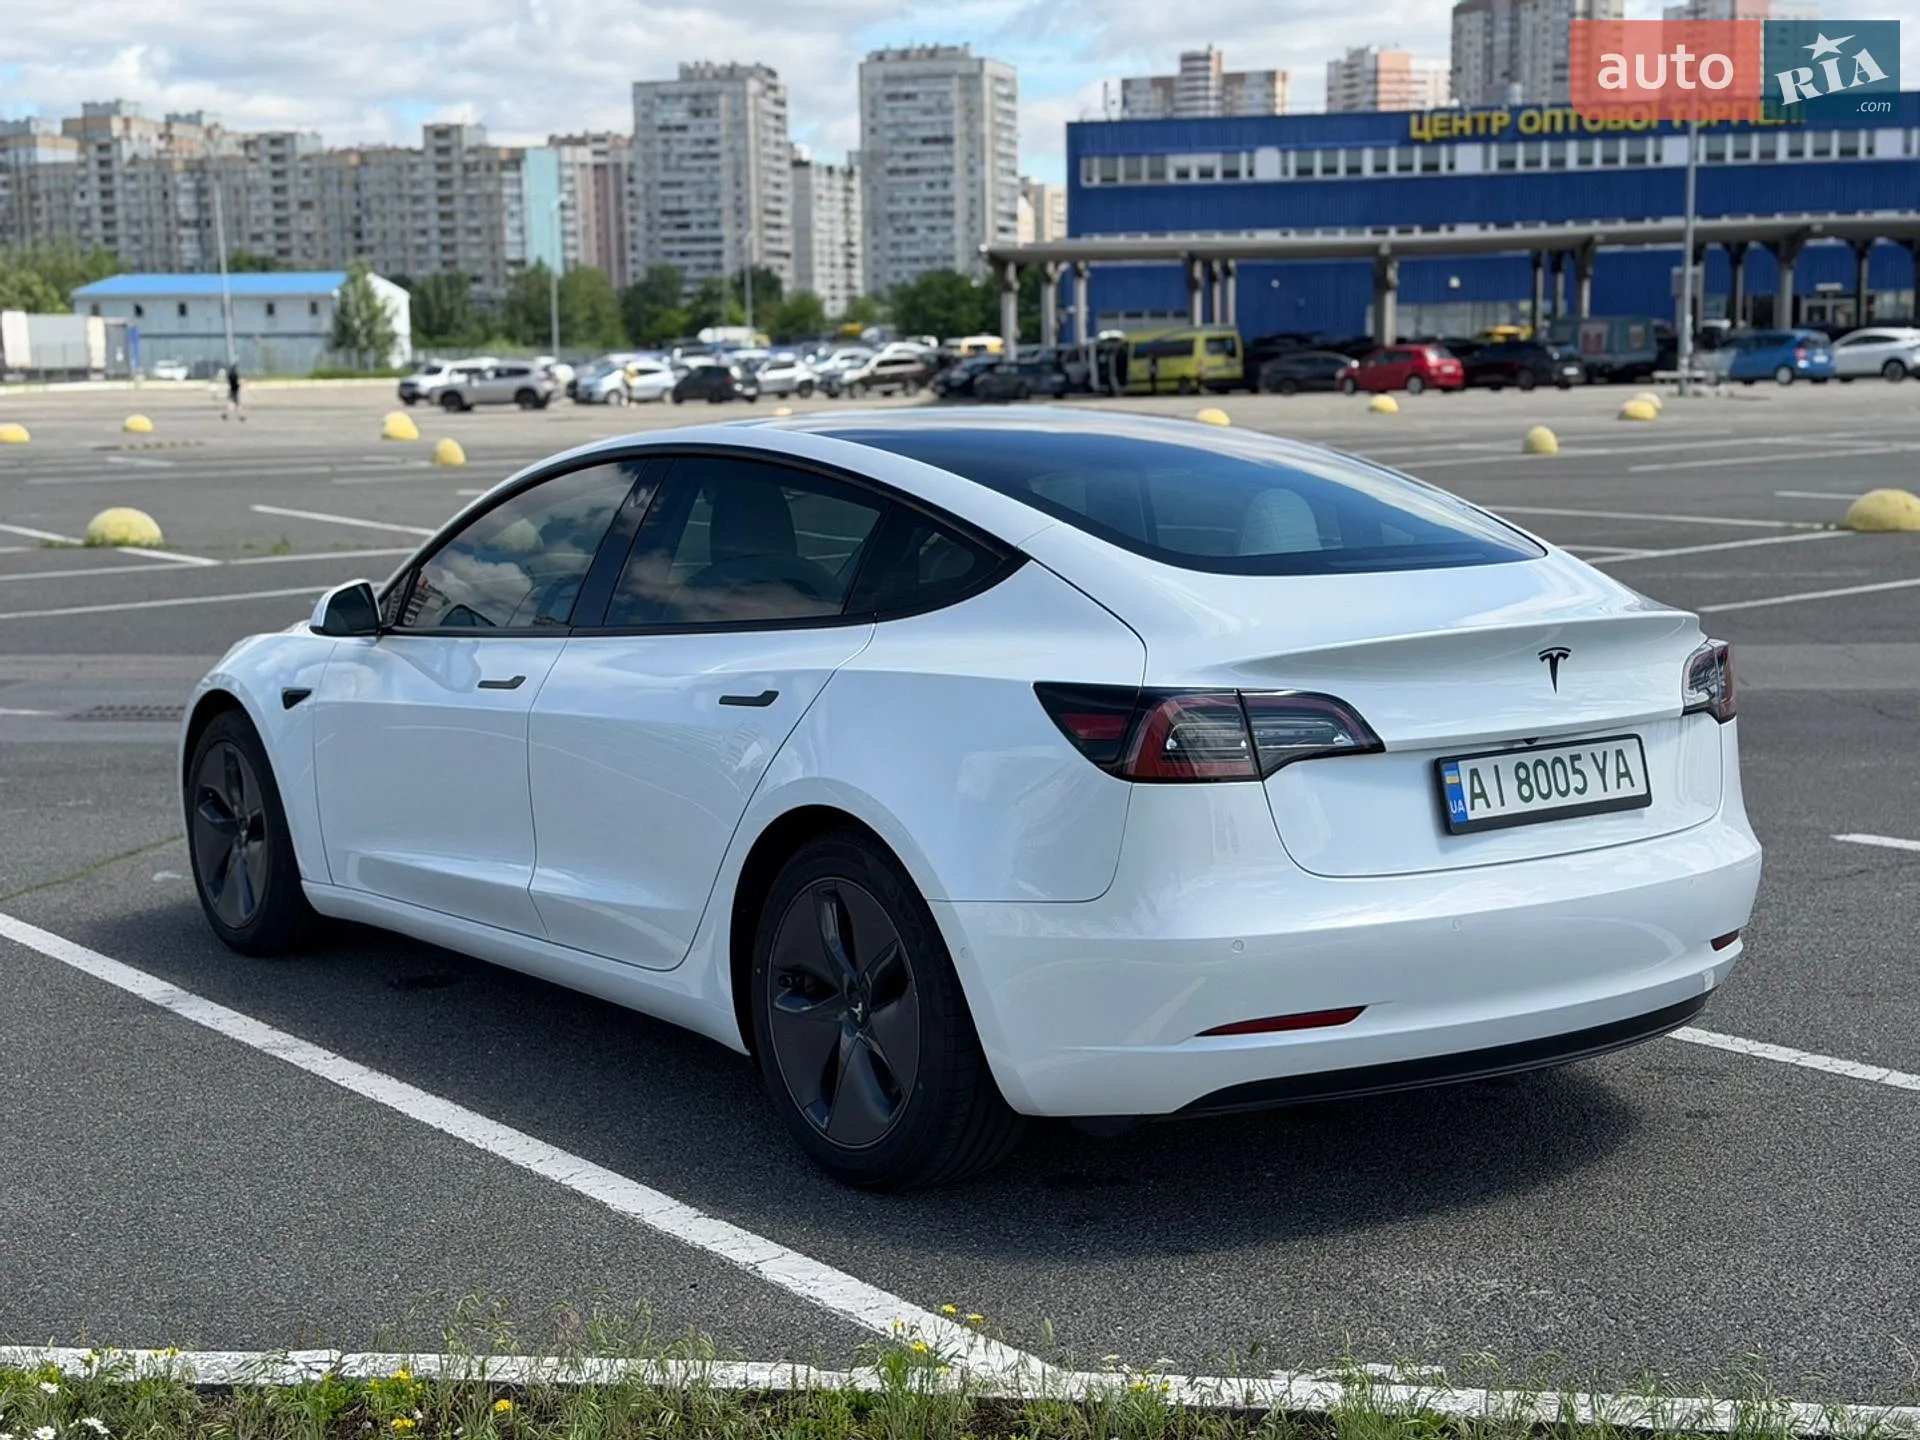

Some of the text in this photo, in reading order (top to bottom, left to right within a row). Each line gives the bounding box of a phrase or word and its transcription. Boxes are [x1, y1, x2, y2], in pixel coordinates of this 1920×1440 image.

[1409, 109, 1511, 142] ЦЕНТР
[1468, 748, 1635, 811] AI 8005 YA
[1449, 799, 1465, 813] UA
